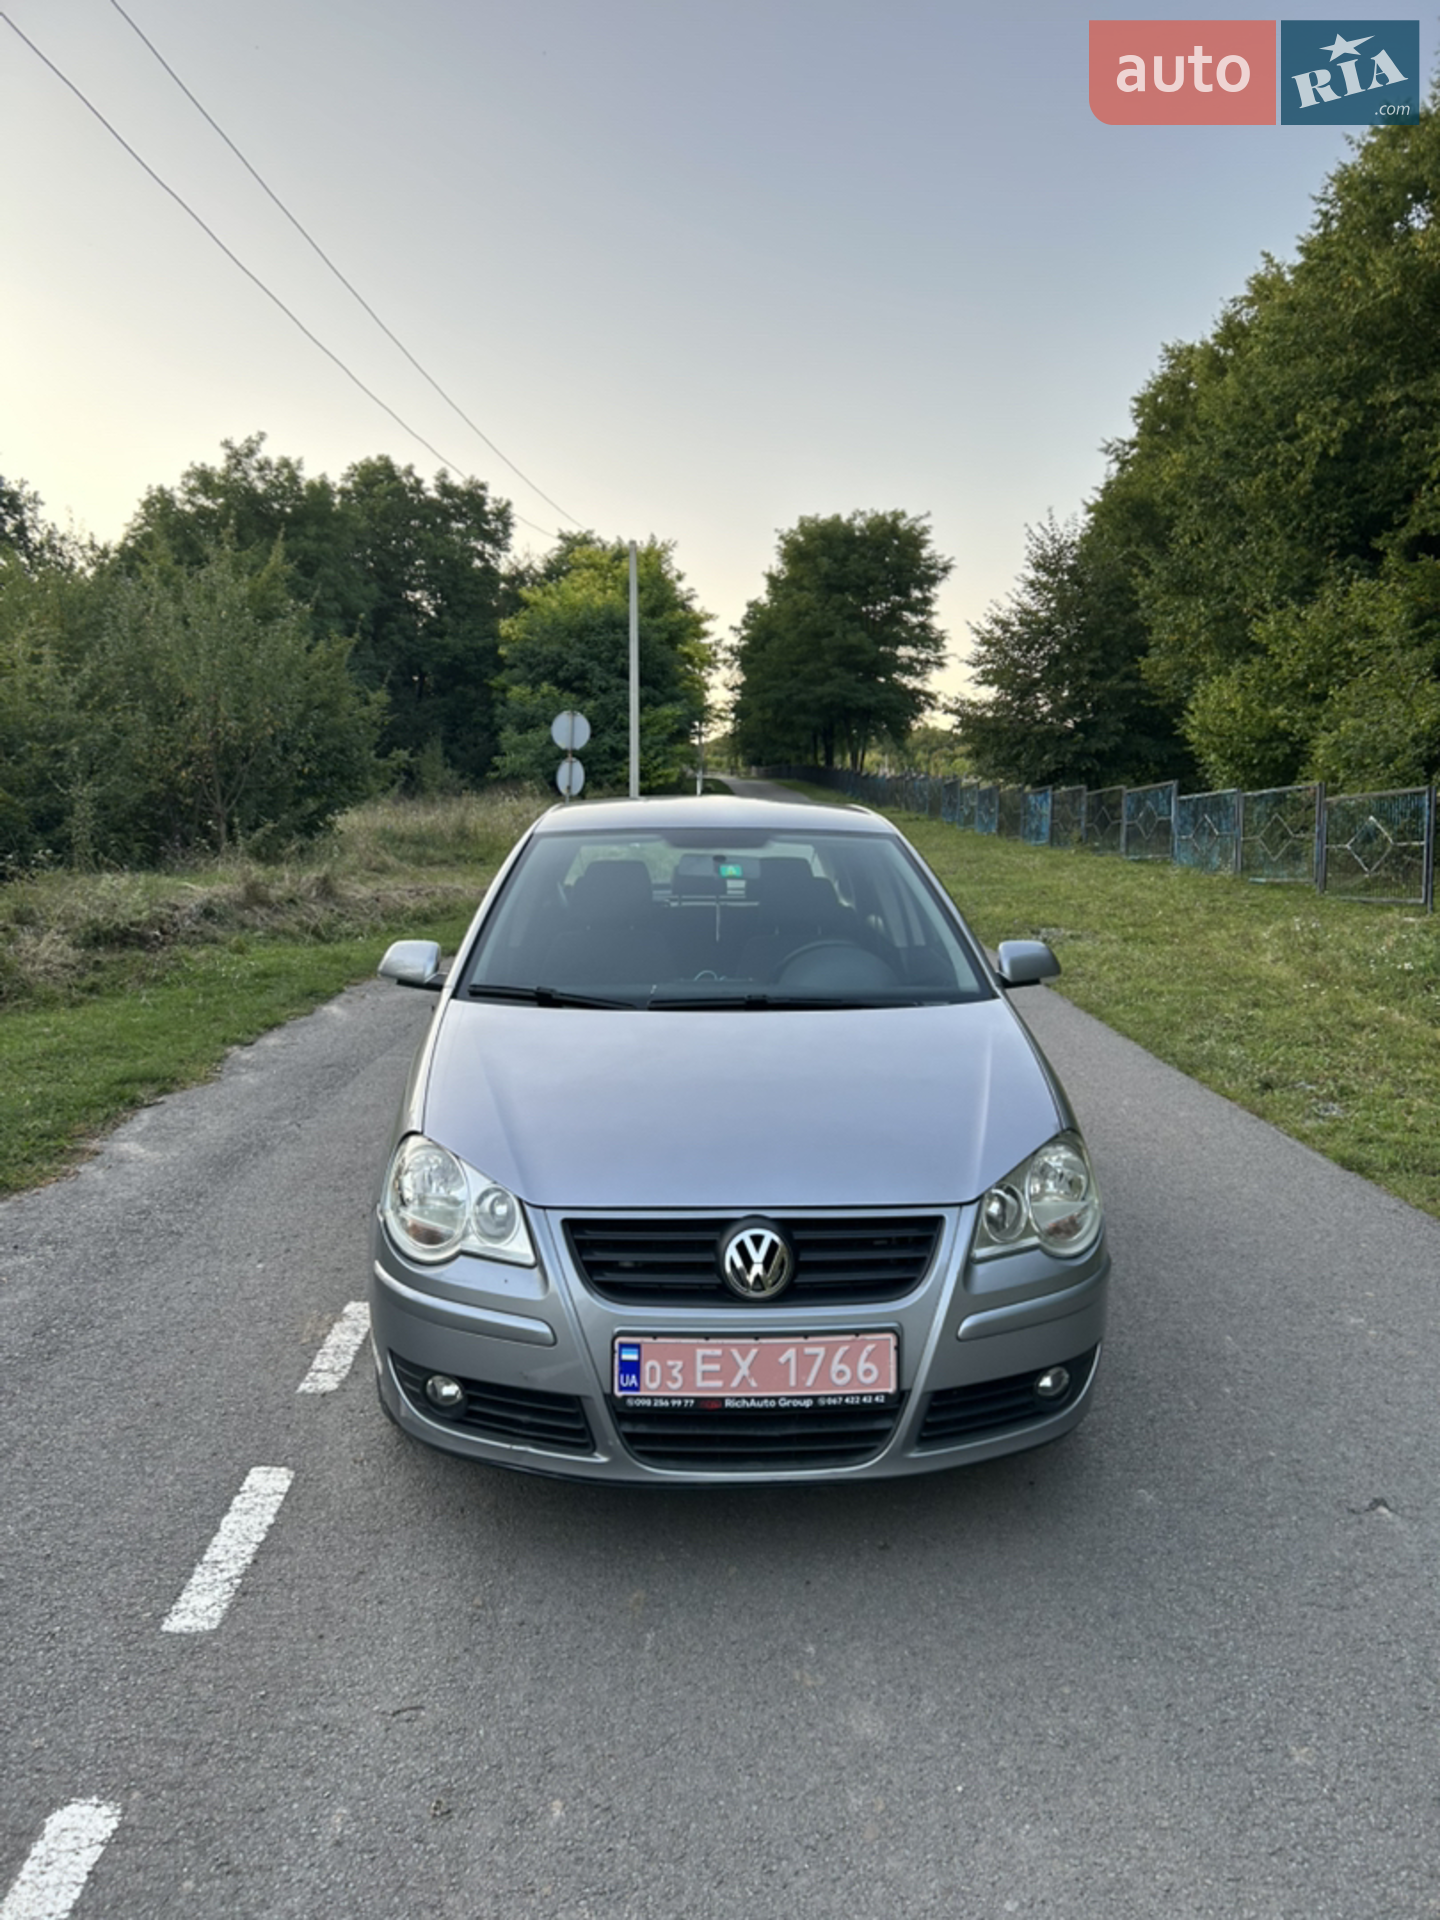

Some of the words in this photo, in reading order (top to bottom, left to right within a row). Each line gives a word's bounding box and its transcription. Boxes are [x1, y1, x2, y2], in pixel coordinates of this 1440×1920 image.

[644, 1360, 684, 1390] 03
[695, 1347, 758, 1388] EX
[778, 1343, 879, 1387] 1766
[619, 1374, 639, 1388] UA
[683, 1398, 695, 1408] 77
[724, 1397, 777, 1409] RichAuto
[778, 1396, 814, 1409] Group
